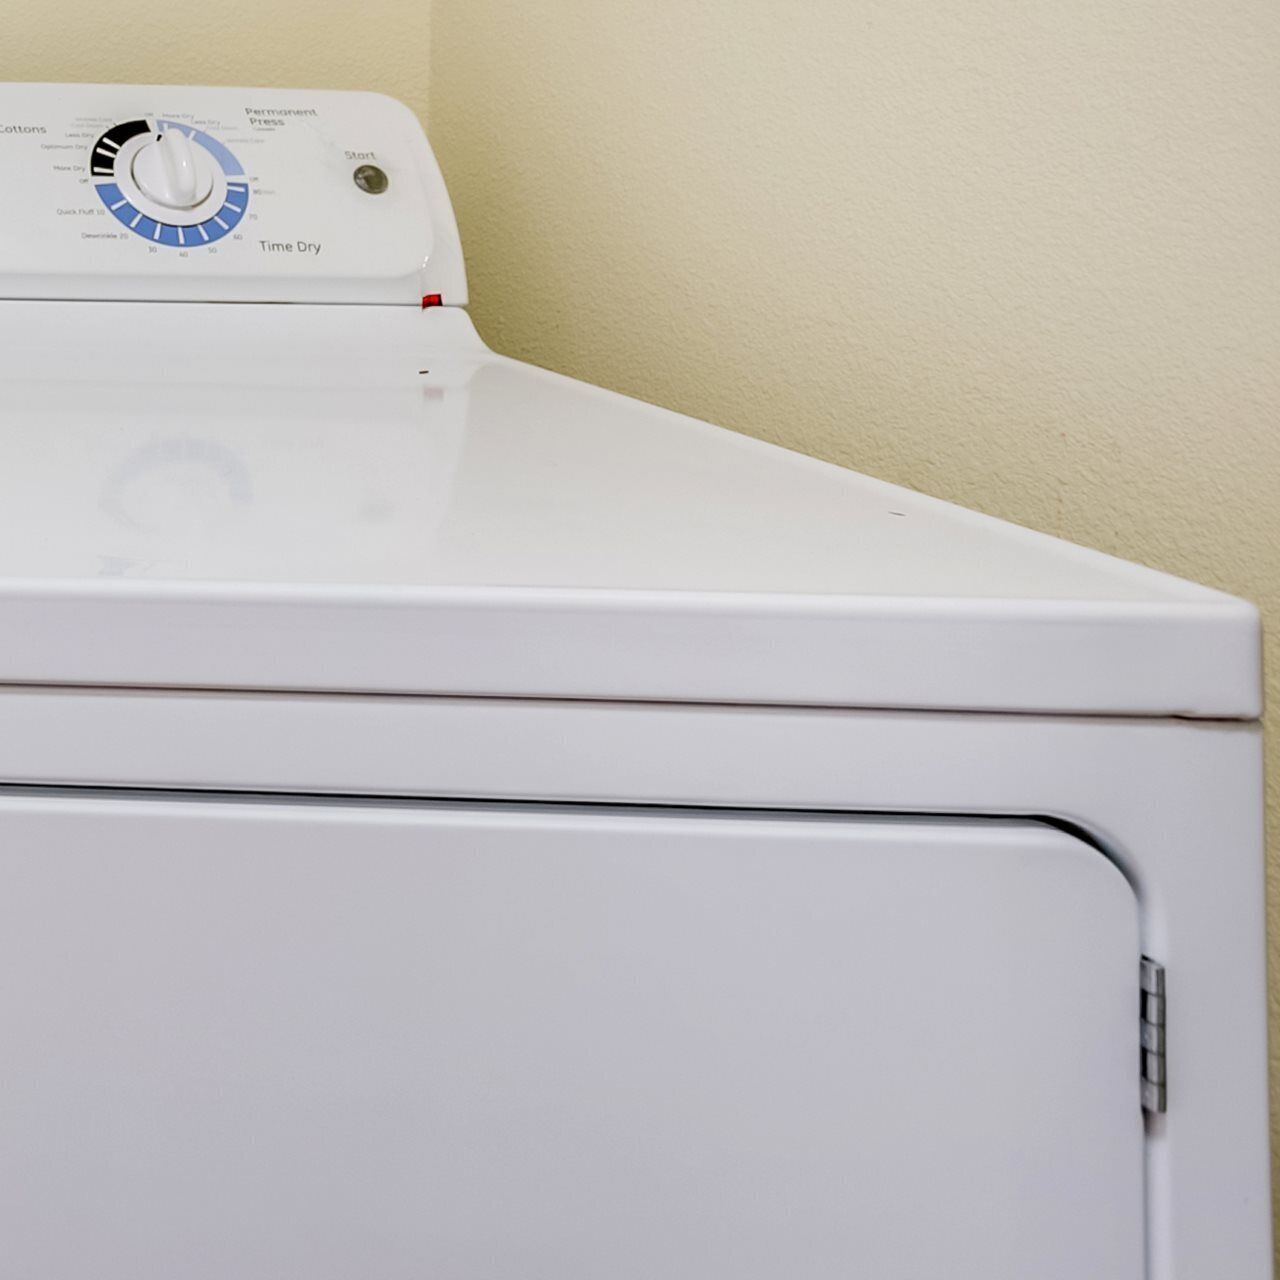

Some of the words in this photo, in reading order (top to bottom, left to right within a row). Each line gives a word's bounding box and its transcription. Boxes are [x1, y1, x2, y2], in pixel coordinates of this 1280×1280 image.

[245, 108, 317, 117] Permanent
[249, 118, 285, 126] Press
[345, 151, 376, 160] Start
[260, 241, 293, 252] Time
[298, 241, 321, 255] Dry
